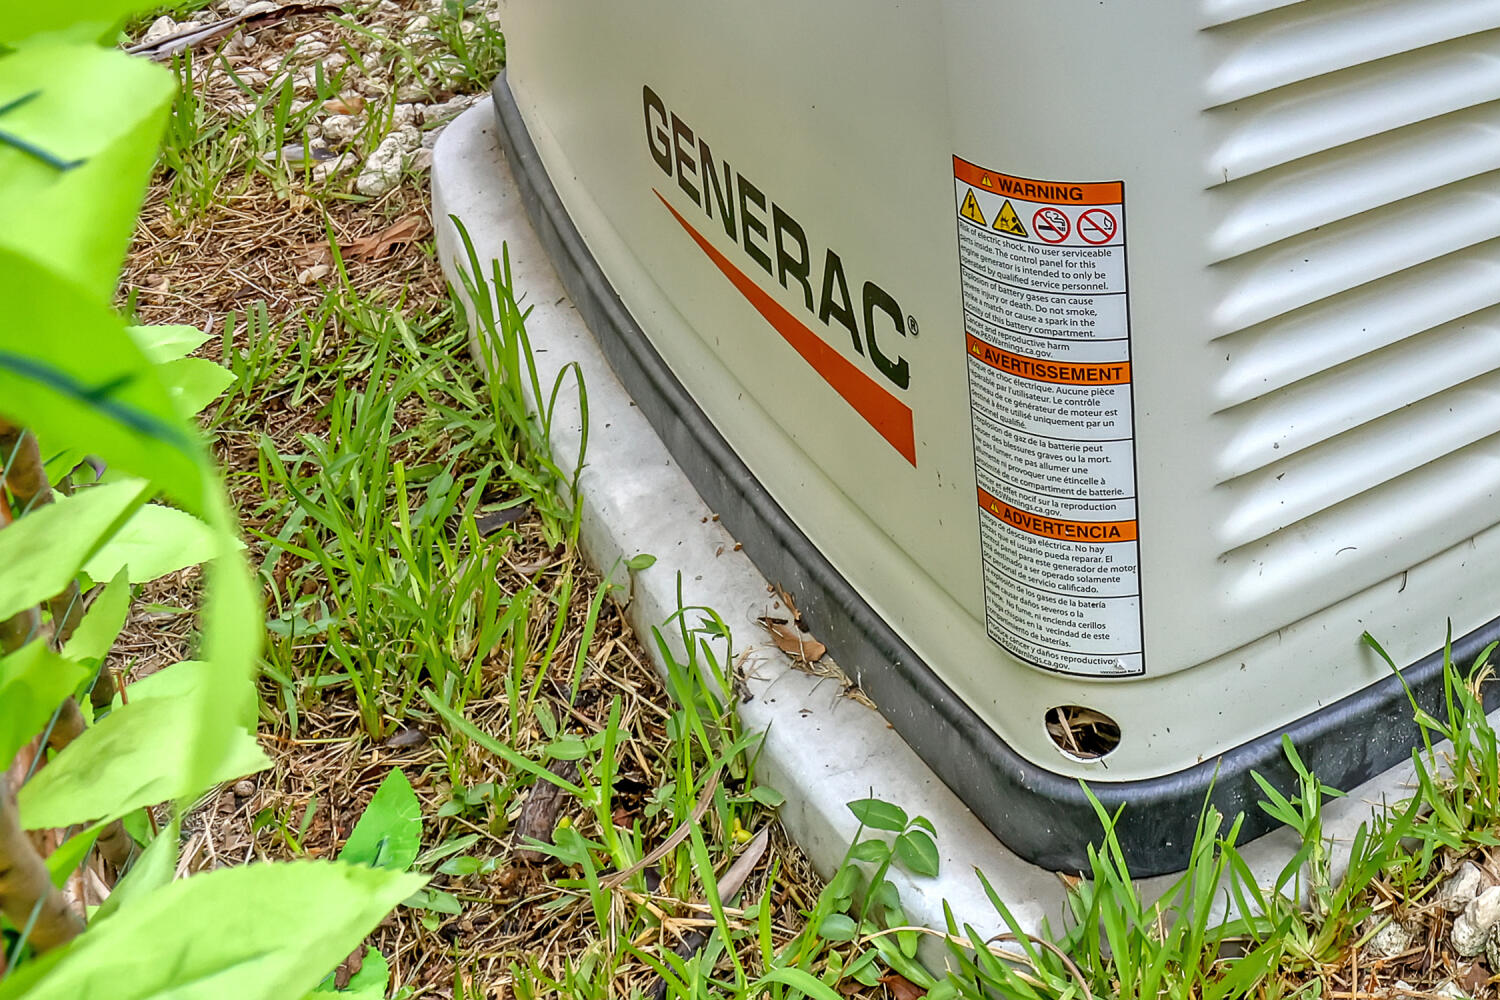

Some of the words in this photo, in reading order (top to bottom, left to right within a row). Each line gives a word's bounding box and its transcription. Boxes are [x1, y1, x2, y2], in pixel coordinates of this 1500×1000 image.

[998, 177, 1083, 201] WARNING
[643, 84, 909, 390] GENERAC
[978, 232, 1001, 245] electric
[1002, 240, 1026, 252] shock.
[1028, 245, 1040, 254] No
[1041, 249, 1060, 257] user
[1062, 248, 1112, 258] serviceable
[980, 254, 1014, 271] generator
[1022, 266, 1060, 278] intended
[1061, 271, 1071, 279] to
[1072, 271, 1093, 281] only
[1094, 271, 1107, 279] be
[995, 248, 1009, 258] The
[1009, 253, 1038, 265] control
[1039, 259, 1063, 268] panel
[1065, 259, 1078, 269] for
[1079, 260, 1096, 269] this
[987, 266, 997, 277] by
[996, 271, 1029, 285] qualified
[1030, 279, 1060, 289] service
[1061, 282, 1109, 291] personnel.
[998, 285, 1025, 300] battery
[1025, 293, 1049, 303] gases
[1005, 309, 1013, 317] or
[1014, 312, 1037, 323] cause
[1045, 317, 1068, 326] spark
[1069, 318, 1078, 327] in
[1079, 318, 1096, 327] the
[1009, 299, 1034, 311] death.
[1035, 304, 1048, 313] Do
[1049, 307, 1064, 315] not
[1065, 308, 1098, 317] smoke,
[991, 313, 1005, 325] this
[1005, 318, 1033, 333] battery
[1034, 326, 1096, 338] compartment.
[985, 325, 997, 335] and
[997, 330, 1046, 348] reproductive
[1047, 341, 1070, 351] harm
[985, 349, 1124, 381] AVERTISSEMENT
[996, 373, 1013, 384] choc
[1013, 378, 1055, 394] électrique.
[1055, 386, 1089, 396] Aucune
[1090, 387, 1116, 397] pièce
[994, 391, 1004, 400] de
[1004, 396, 1013, 405] ce
[1013, 398, 1057, 414] générateur
[1057, 407, 1069, 416] de
[1070, 409, 1102, 417] moteur
[1104, 409, 1118, 417] est
[1052, 396, 1063, 405] Le
[1064, 398, 1101, 407] contrôle
[995, 402, 1009, 414] être
[1010, 409, 1032, 421] utilisé
[1033, 415, 1085, 428] uniquement
[1086, 420, 1101, 430] par
[1003, 430, 1013, 439] de
[1013, 434, 1027, 444] gaz
[1027, 437, 1038, 446] de
[1039, 439, 1047, 448] la
[1047, 441, 1081, 452] batterie
[1082, 445, 1103, 453] peut
[1003, 440, 1036, 457] blessures
[1036, 451, 1063, 462] graves
[1064, 455, 1076, 463] ou
[1078, 455, 1086, 463] la
[1008, 464, 1045, 480] provoquer
[1046, 475, 1062, 483] une
[1063, 475, 1099, 486] étincelle
[1100, 477, 1106, 485] à
[1024, 458, 1038, 468] pas
[1039, 462, 1070, 473] allumer
[1001, 471, 1010, 479] de
[1010, 475, 1019, 483] ce
[1019, 479, 1075, 496] compartiment
[1076, 488, 1088, 496] de
[1089, 487, 1125, 497] batterie.
[1018, 492, 1037, 503] nocif
[1038, 498, 1050, 506] sur
[1051, 499, 1059, 508] la
[1060, 502, 1117, 511] reproduction
[1003, 507, 1121, 539] ADVERTENCIA
[1006, 528, 1037, 545] descarga
[1037, 539, 1074, 552] eléctrica.
[1074, 544, 1087, 553] No
[1088, 545, 1105, 555] hay
[1016, 542, 1043, 556] usuario
[1044, 551, 1070, 561] pueda
[1071, 555, 1104, 564] reparar.
[1105, 555, 1113, 563] El
[1018, 553, 1035, 564] para
[1035, 559, 1051, 568] este
[1052, 563, 1095, 573] generador
[1097, 565, 1109, 573] de
[1110, 565, 1137, 573] motor
[1017, 571, 1027, 580] de
[1028, 576, 1056, 588] servicio
[1057, 582, 1099, 593] calificado.
[1041, 571, 1075, 581] operado
[1076, 575, 1121, 584] solamente
[1016, 585, 1025, 594] de
[1025, 588, 1036, 598] los
[1036, 593, 1057, 604] gases
[1057, 597, 1068, 606] de
[1069, 599, 1077, 607] la
[1078, 599, 1106, 609] batería
[1040, 605, 1069, 617] severos
[1076, 610, 1084, 618] la
[1026, 620, 1036, 628] en
[1036, 623, 1043, 631] la
[1045, 627, 1080, 639] vecindad
[1081, 631, 1092, 640] de
[1042, 616, 1077, 628] encienda
[1078, 621, 1107, 630] cerillos
[1030, 631, 1040, 640] de
[1040, 634, 1072, 648] baterías.
[1036, 648, 1060, 660] daños
[1060, 655, 1118, 665] reproductivo
